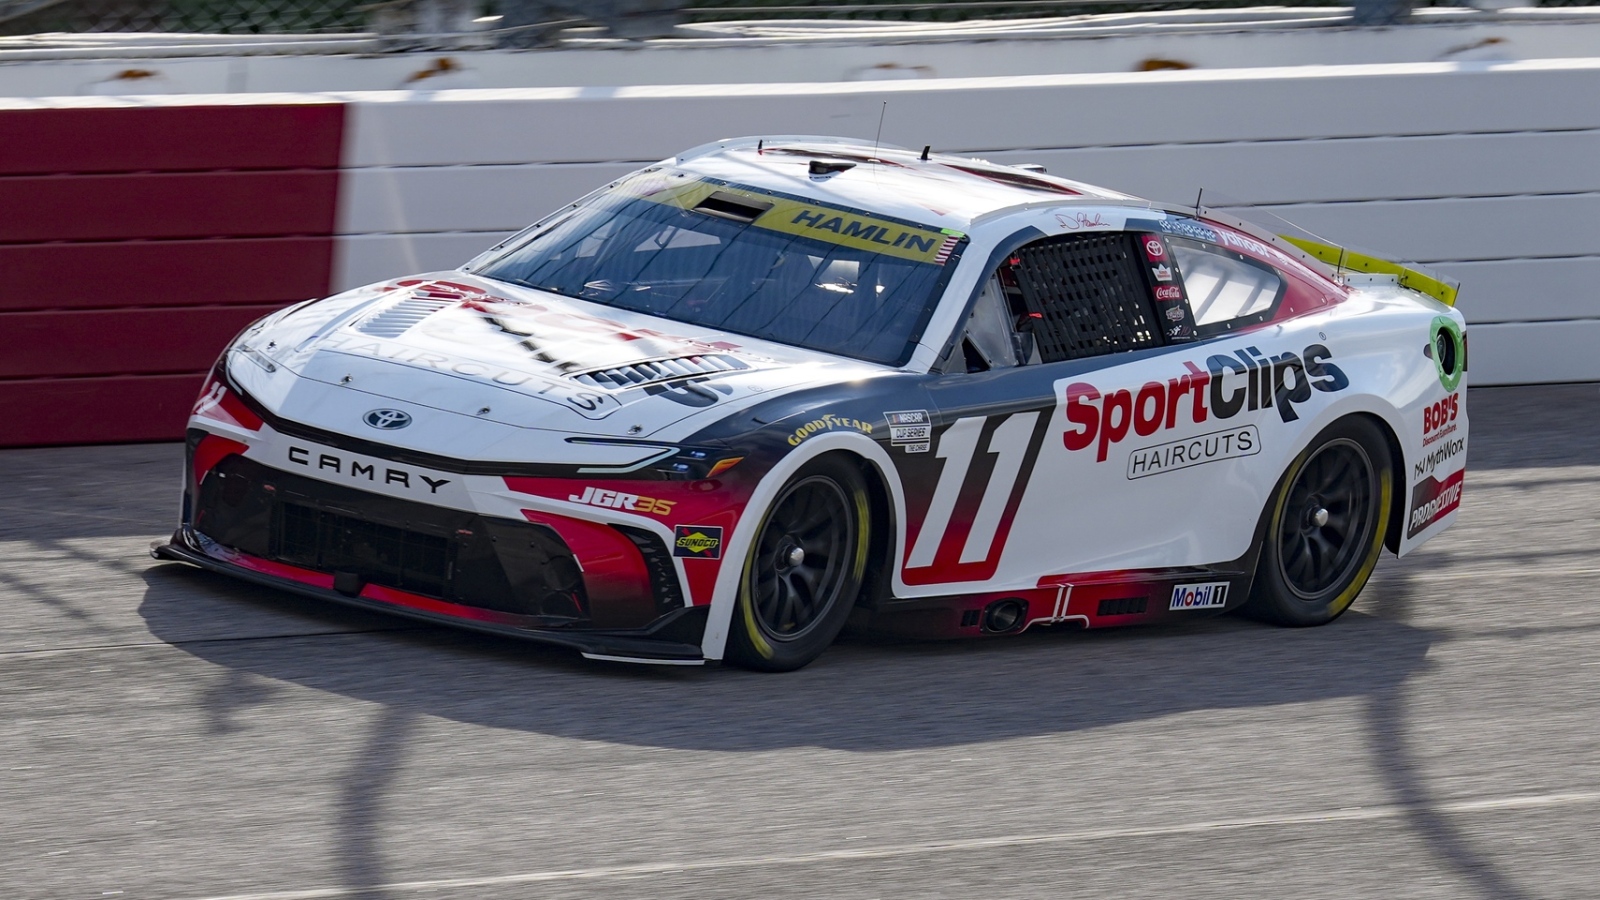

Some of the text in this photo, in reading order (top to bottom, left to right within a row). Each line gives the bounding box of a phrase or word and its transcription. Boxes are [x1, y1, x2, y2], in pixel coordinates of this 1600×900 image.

[791, 209, 936, 253] HAMLIN
[1214, 229, 1271, 259] yahoo!
[787, 413, 873, 446] GOODYEAR
[898, 412, 924, 423] NASCAR
[1423, 392, 1459, 435] BOB'S
[906, 427, 926, 438] SERIES
[1132, 430, 1253, 475] HAIRCUTS
[288, 445, 452, 494] CAMRY
[904, 410, 1042, 570] 11
[678, 538, 718, 547] SUNOCO
[1171, 585, 1223, 607] Mobil 1
